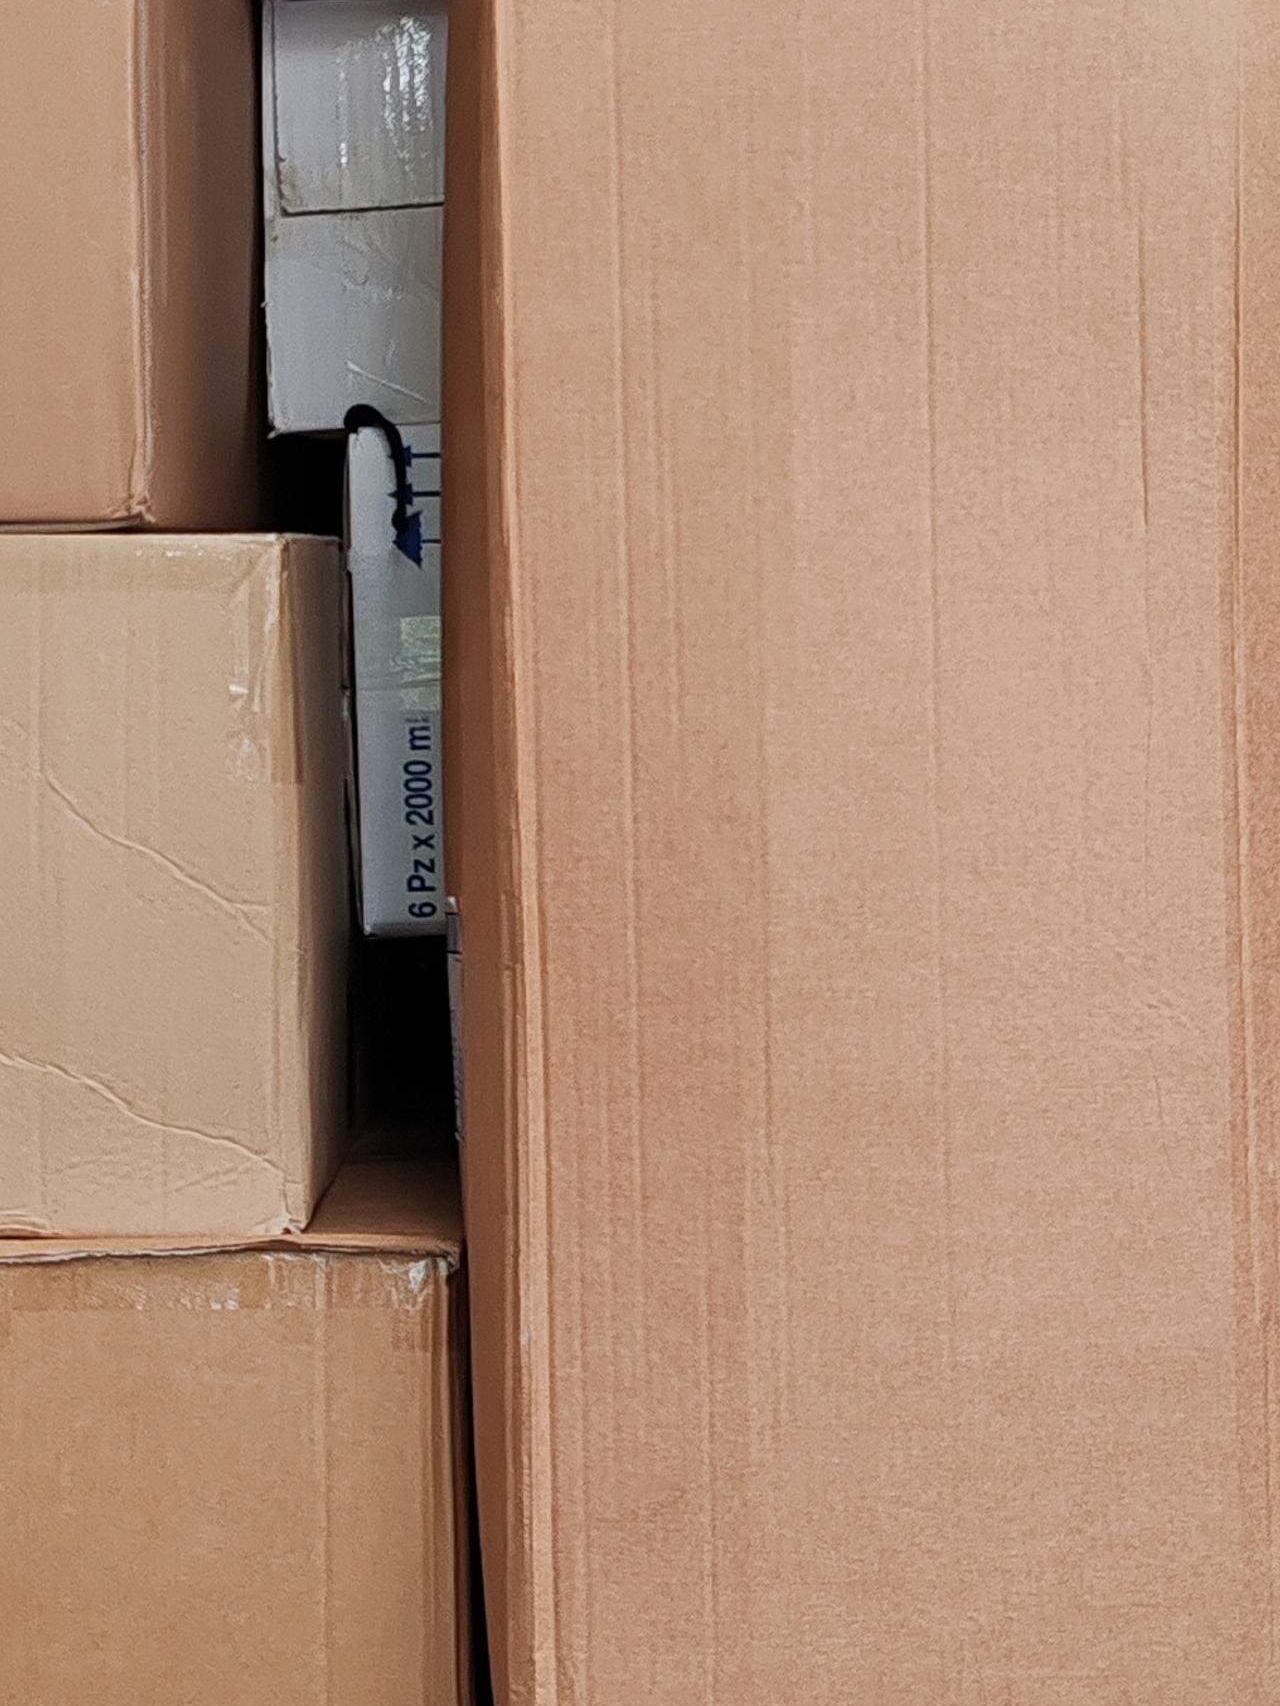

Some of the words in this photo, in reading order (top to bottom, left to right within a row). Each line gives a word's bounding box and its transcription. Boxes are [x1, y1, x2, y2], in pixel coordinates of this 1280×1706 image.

[403, 759, 436, 826] 2000
[411, 834, 435, 850] x
[406, 857, 437, 893] Pz
[407, 901, 438, 919] 6
